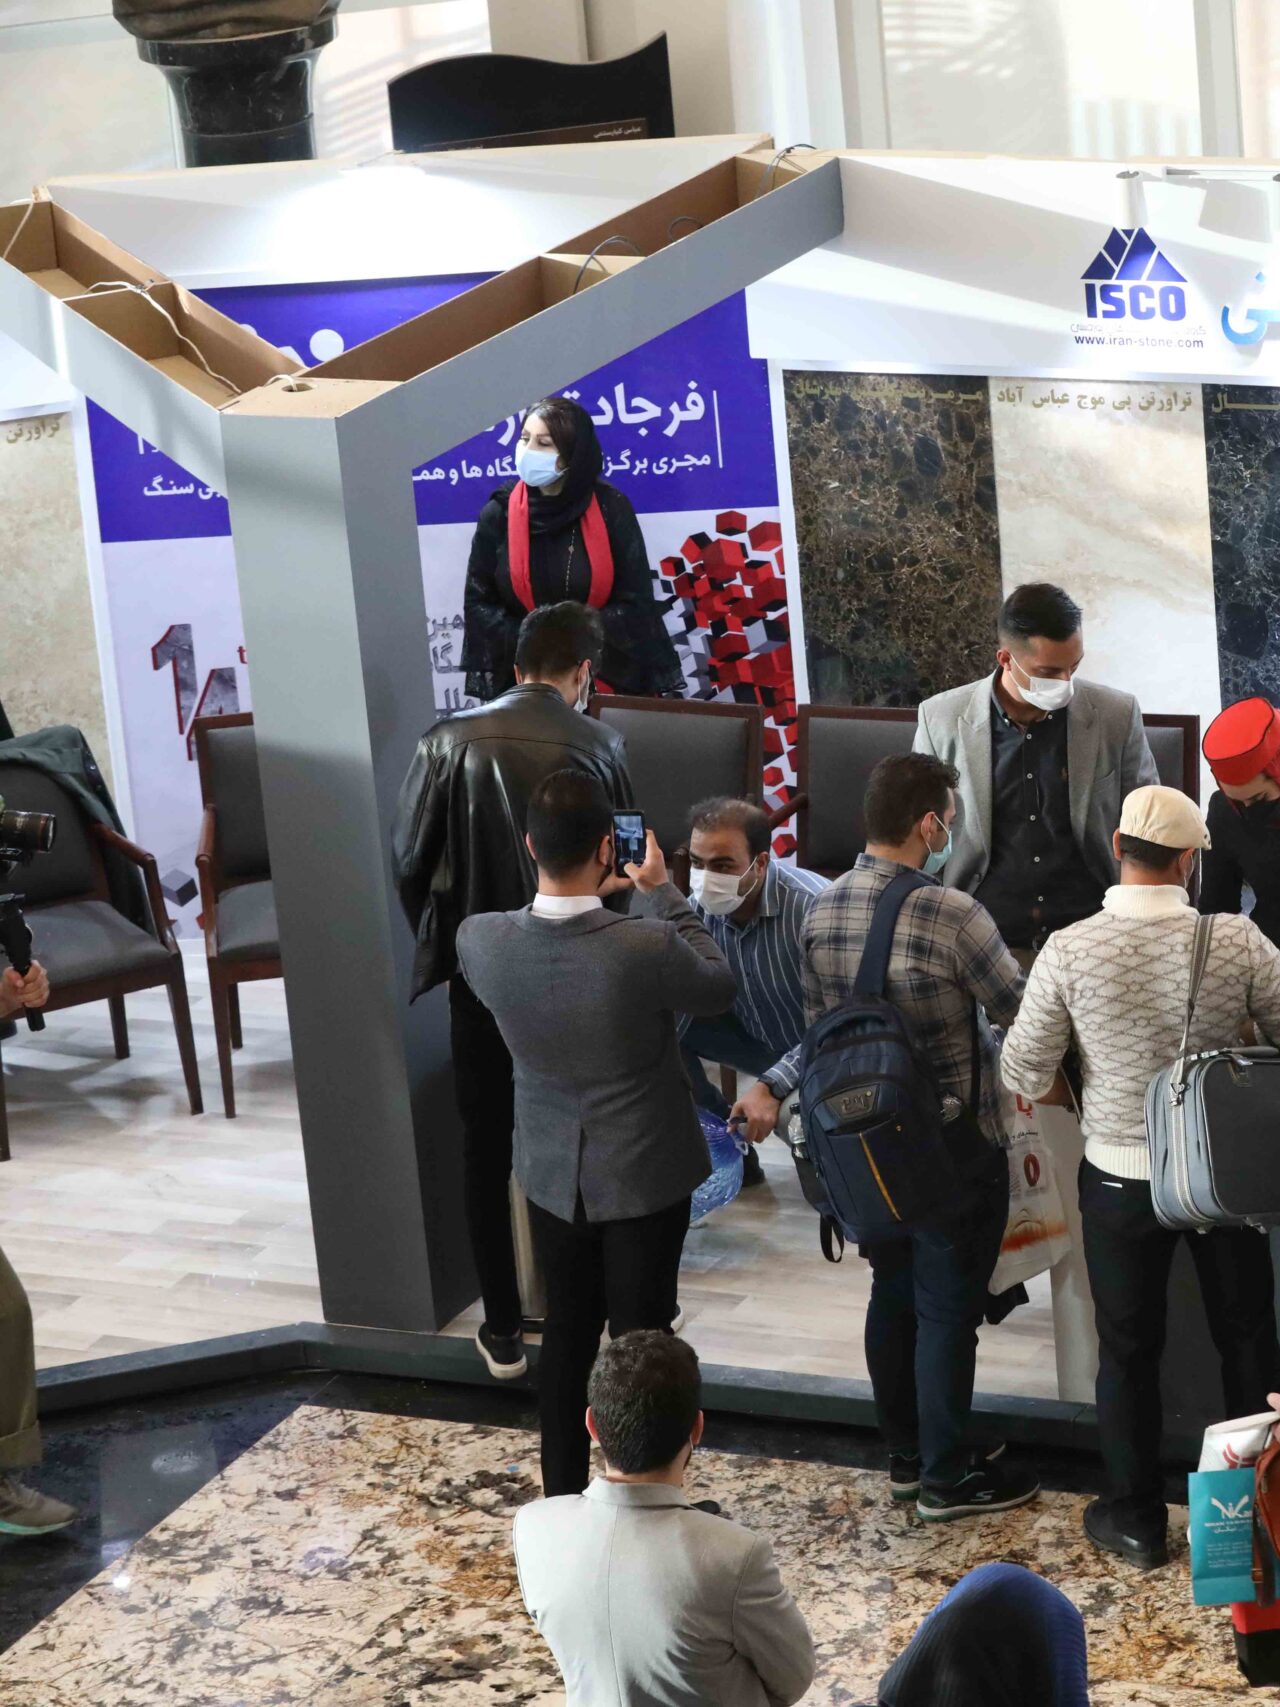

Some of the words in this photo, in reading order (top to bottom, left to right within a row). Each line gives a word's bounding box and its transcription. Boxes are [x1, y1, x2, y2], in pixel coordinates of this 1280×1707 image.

[1084, 282, 1188, 322] ISCO
[1074, 334, 1205, 350] www.iran-stone.com
[996, 385, 1025, 408] آباد
[1032, 388, 1071, 409] عباس
[1076, 393, 1106, 411] موج
[1111, 393, 1132, 412] بی
[1137, 389, 1193, 412] تراورتن
[460, 459, 483, 478] ها
[651, 454, 711, 475] مجری
[143, 474, 195, 497] سنگ
[449, 467, 460, 486] و
